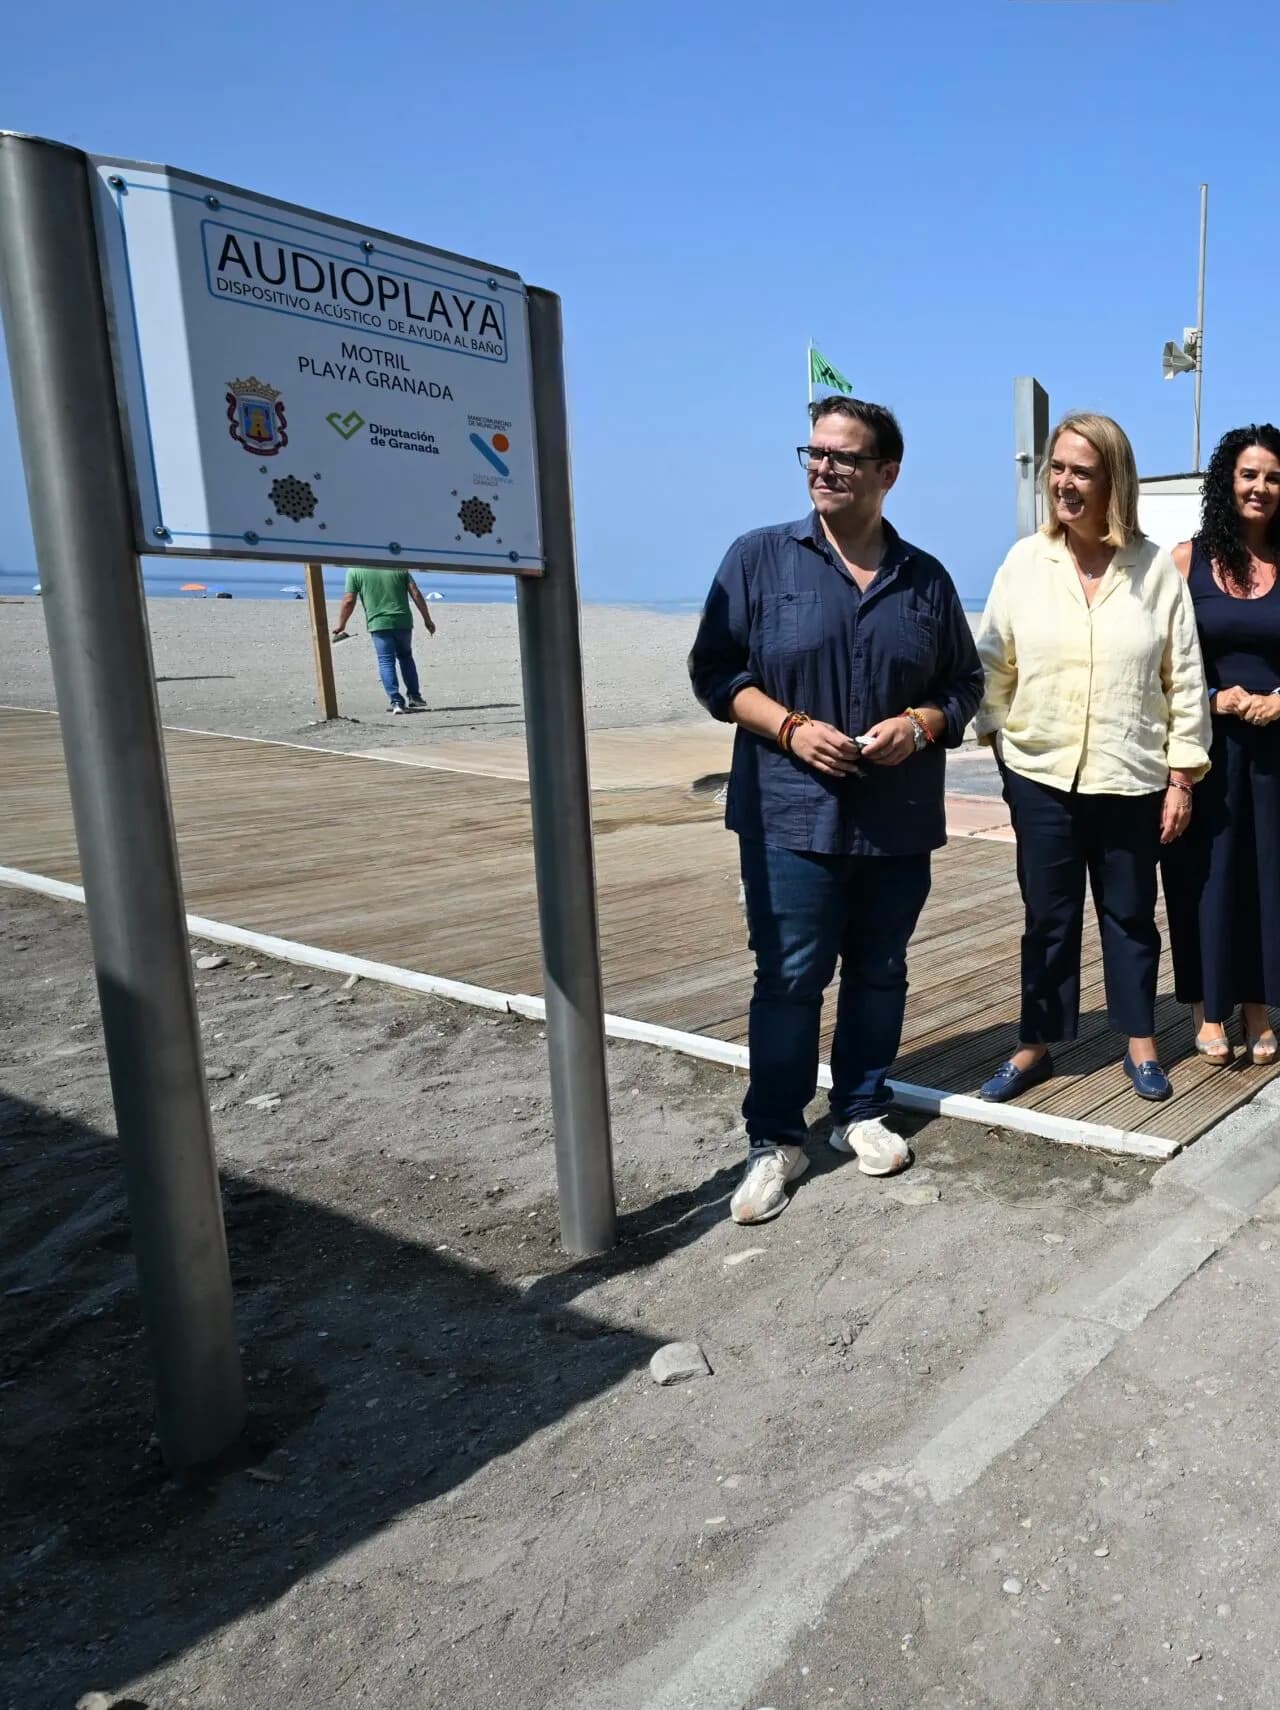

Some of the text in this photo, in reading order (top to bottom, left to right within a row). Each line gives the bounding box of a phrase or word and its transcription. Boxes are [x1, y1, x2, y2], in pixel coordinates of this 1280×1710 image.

[217, 233, 504, 341] AUDIOPLAYA
[216, 276, 503, 356] DISPOSITIVO ACÚSTICO DE AYUDA AL BAÑO
[341, 342, 411, 372] MOTRIL
[298, 355, 454, 402] PLAYA GRANADA
[369, 423, 435, 443] Diputación
[370, 435, 440, 455] de Granada
